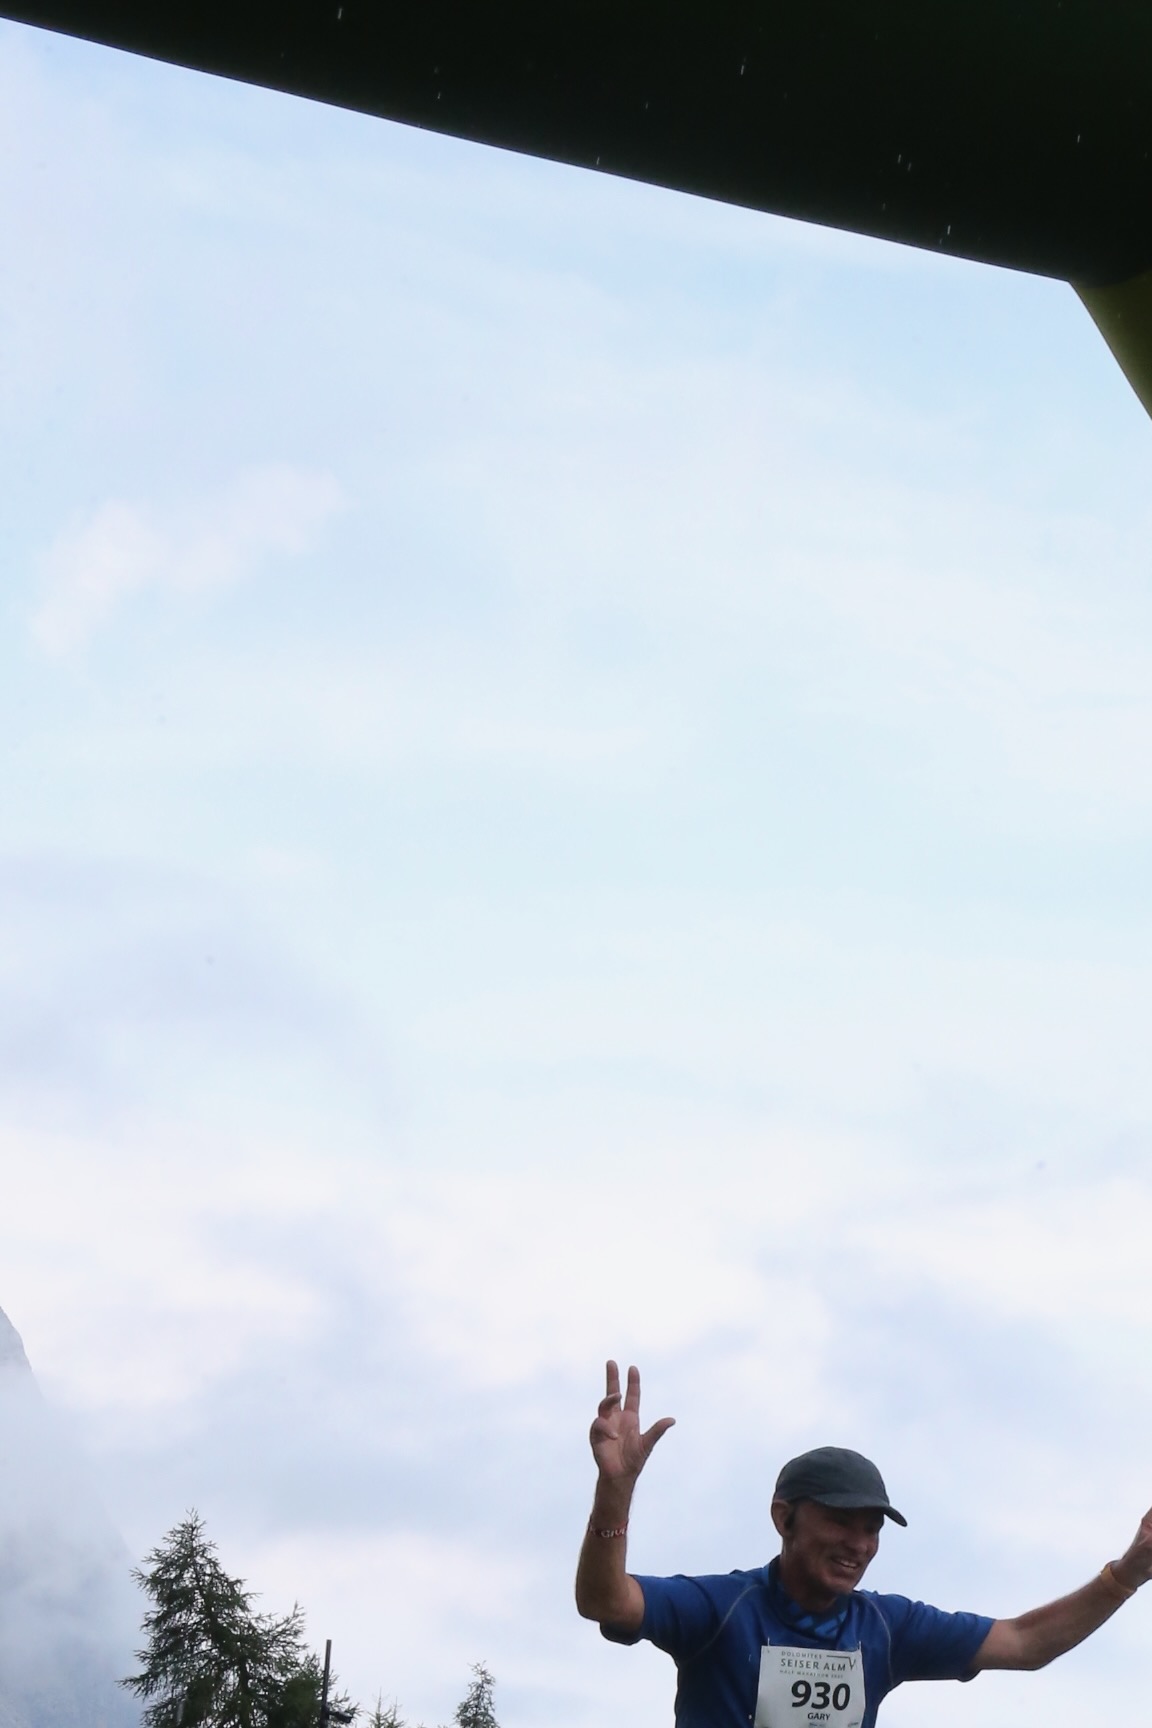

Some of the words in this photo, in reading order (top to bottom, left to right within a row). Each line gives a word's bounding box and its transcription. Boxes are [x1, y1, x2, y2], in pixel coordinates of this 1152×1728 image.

[781, 1650, 822, 1659] DOLOMITES
[780, 1658, 820, 1670] SEISER
[823, 1662, 846, 1671] ALM
[791, 1680, 851, 1711] 930
[807, 1712, 830, 1720] GARY
